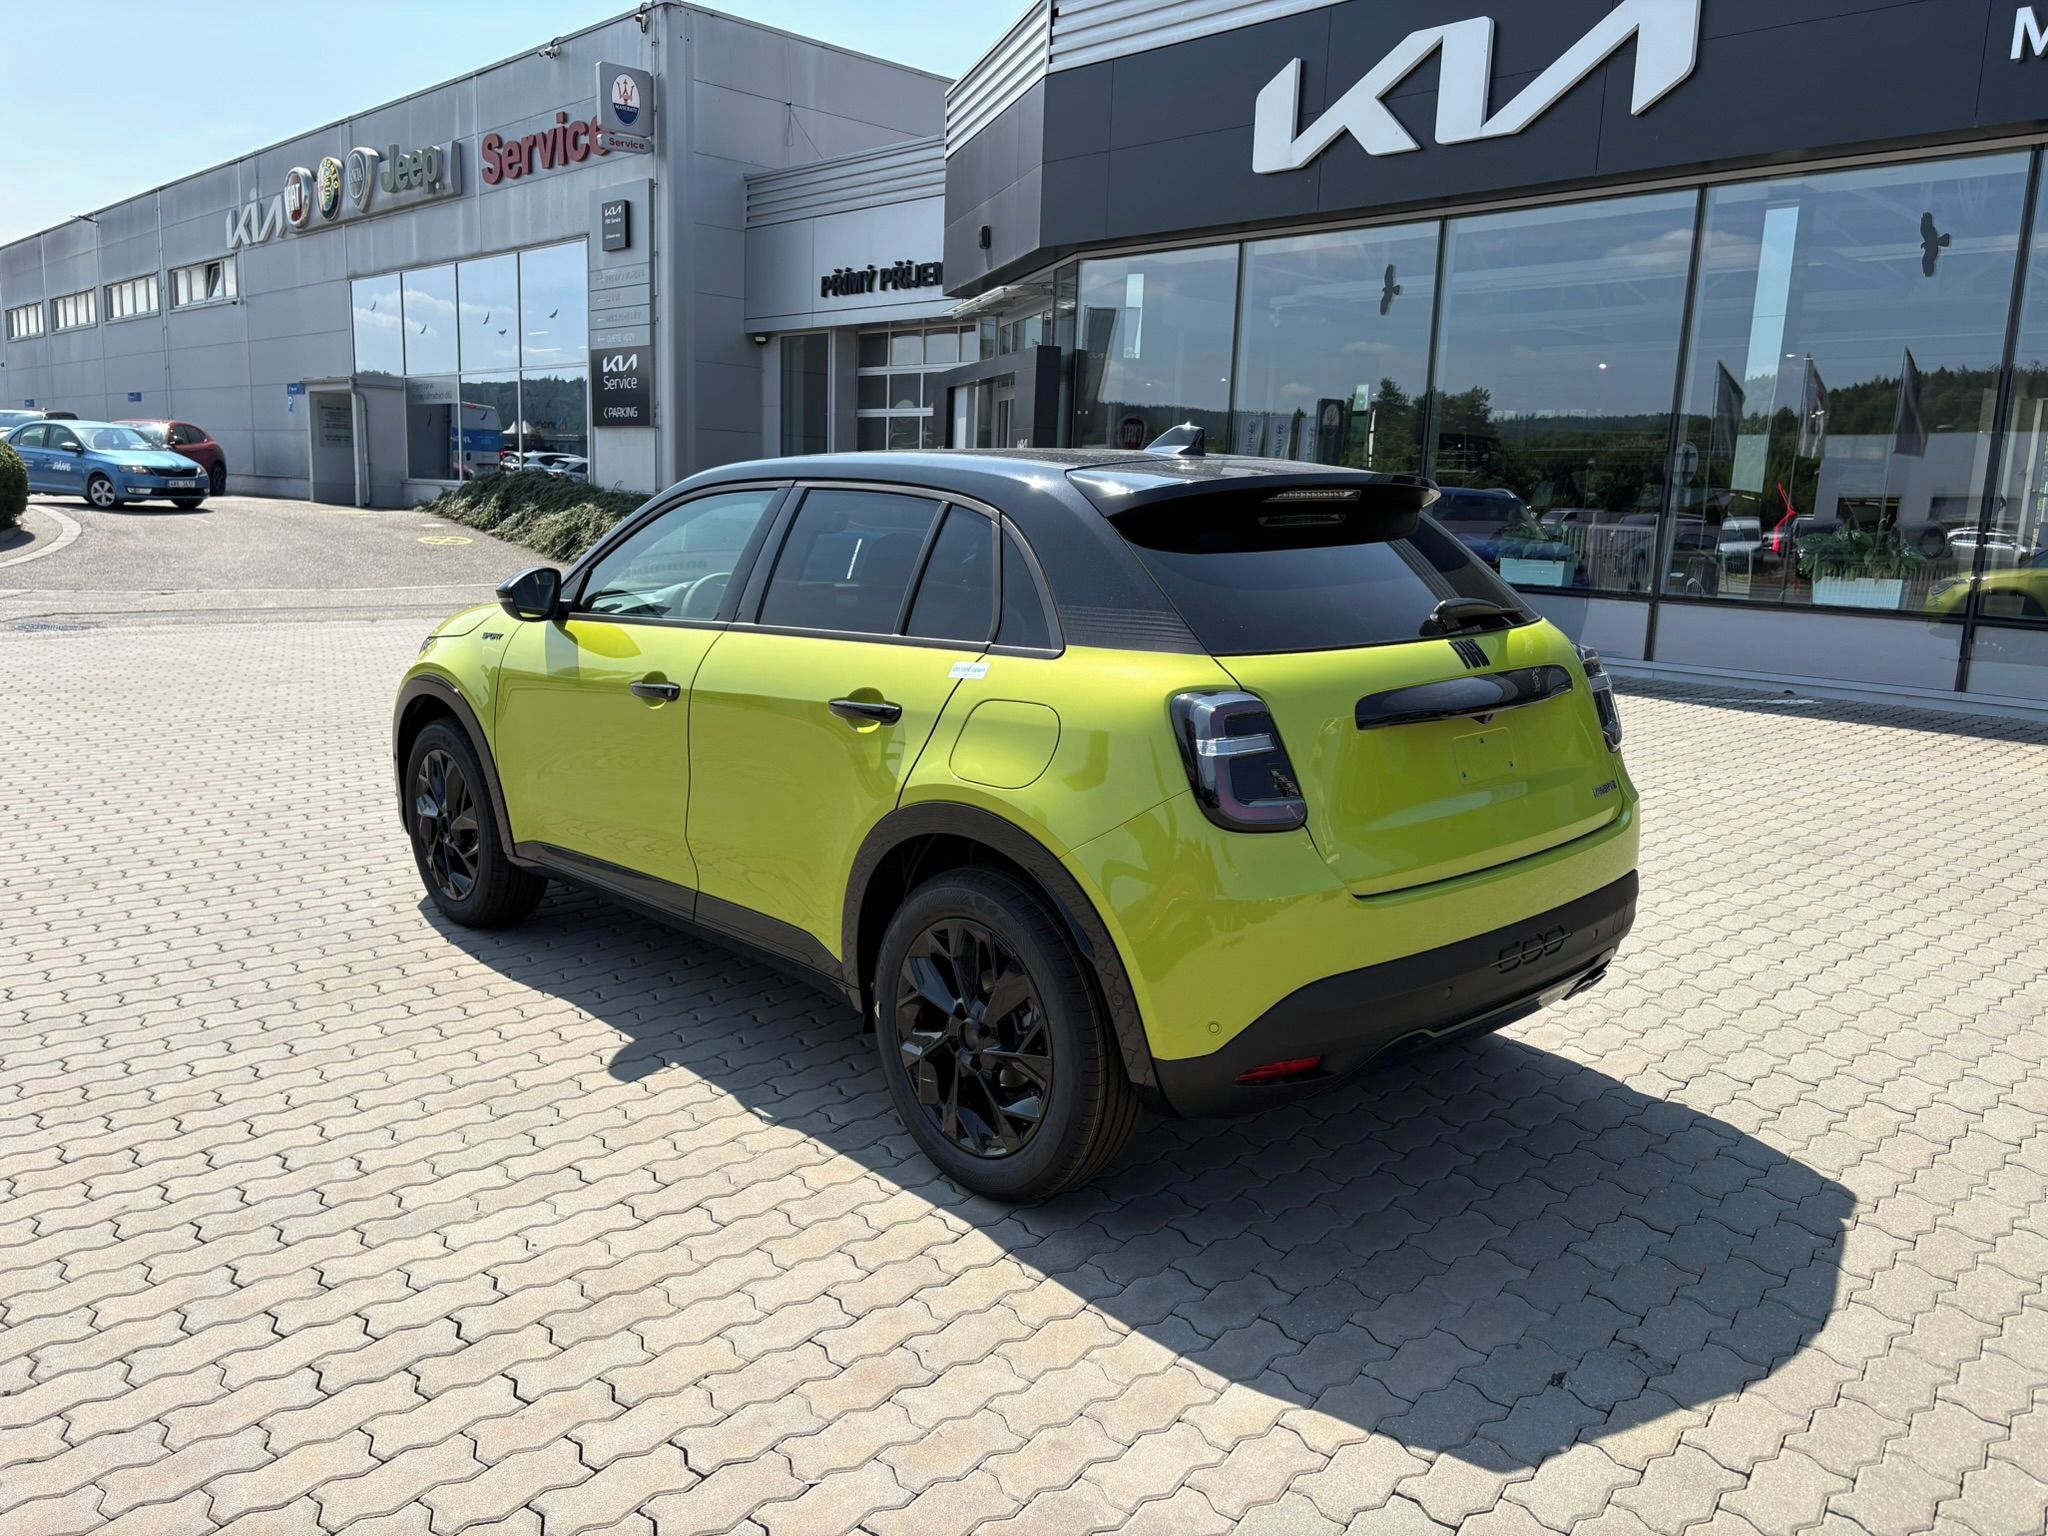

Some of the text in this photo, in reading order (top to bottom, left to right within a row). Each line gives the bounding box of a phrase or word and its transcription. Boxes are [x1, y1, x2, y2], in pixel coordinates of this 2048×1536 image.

[1253, 0, 1700, 174] KIA
[608, 137, 645, 150] Service
[380, 144, 441, 194] Jeep
[604, 205, 622, 217] KIA
[225, 194, 286, 249] KIA
[820, 264, 878, 298] PŘÍMÝ
[602, 354, 638, 373] KIA
[603, 374, 638, 390] Service
[608, 406, 638, 418] PARKING
